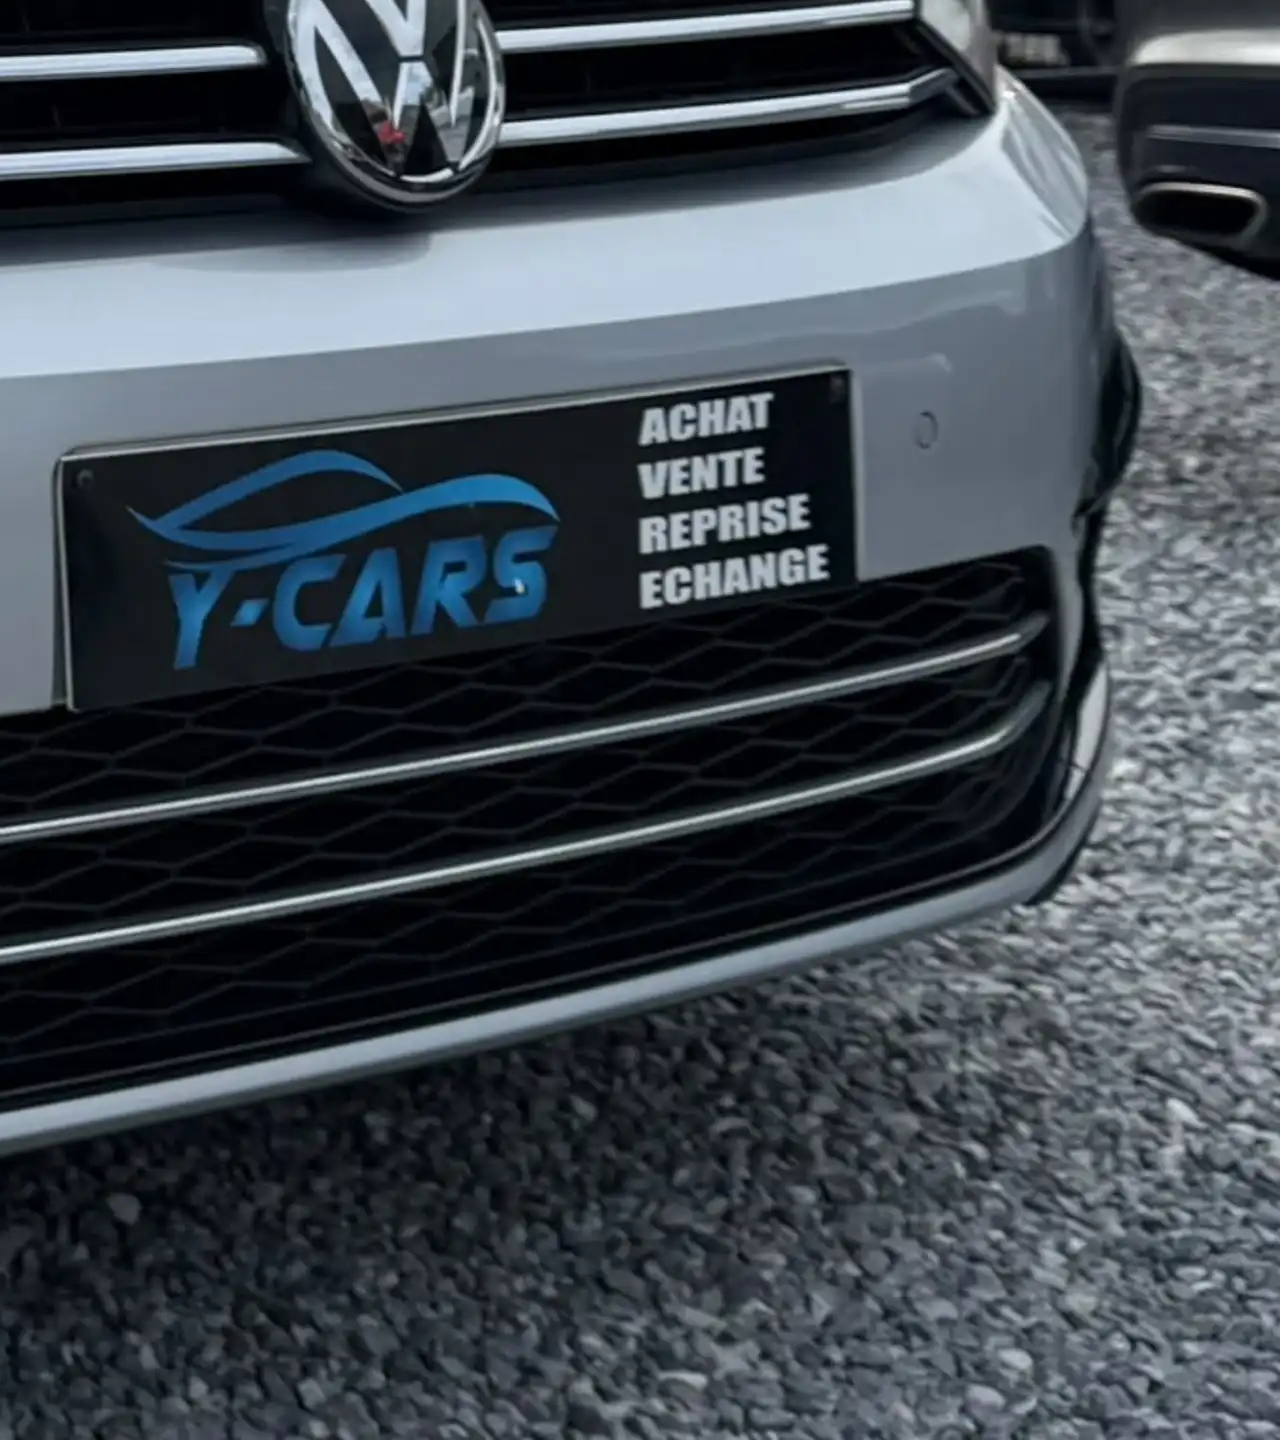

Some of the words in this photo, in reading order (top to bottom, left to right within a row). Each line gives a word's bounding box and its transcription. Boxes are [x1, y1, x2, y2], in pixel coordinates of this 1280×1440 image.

[638, 392, 774, 446] ACHAT
[637, 447, 766, 499] VENTE
[638, 493, 811, 554] REPRISE
[165, 524, 559, 670] Y-CARS
[639, 544, 830, 609] ECHANGE
